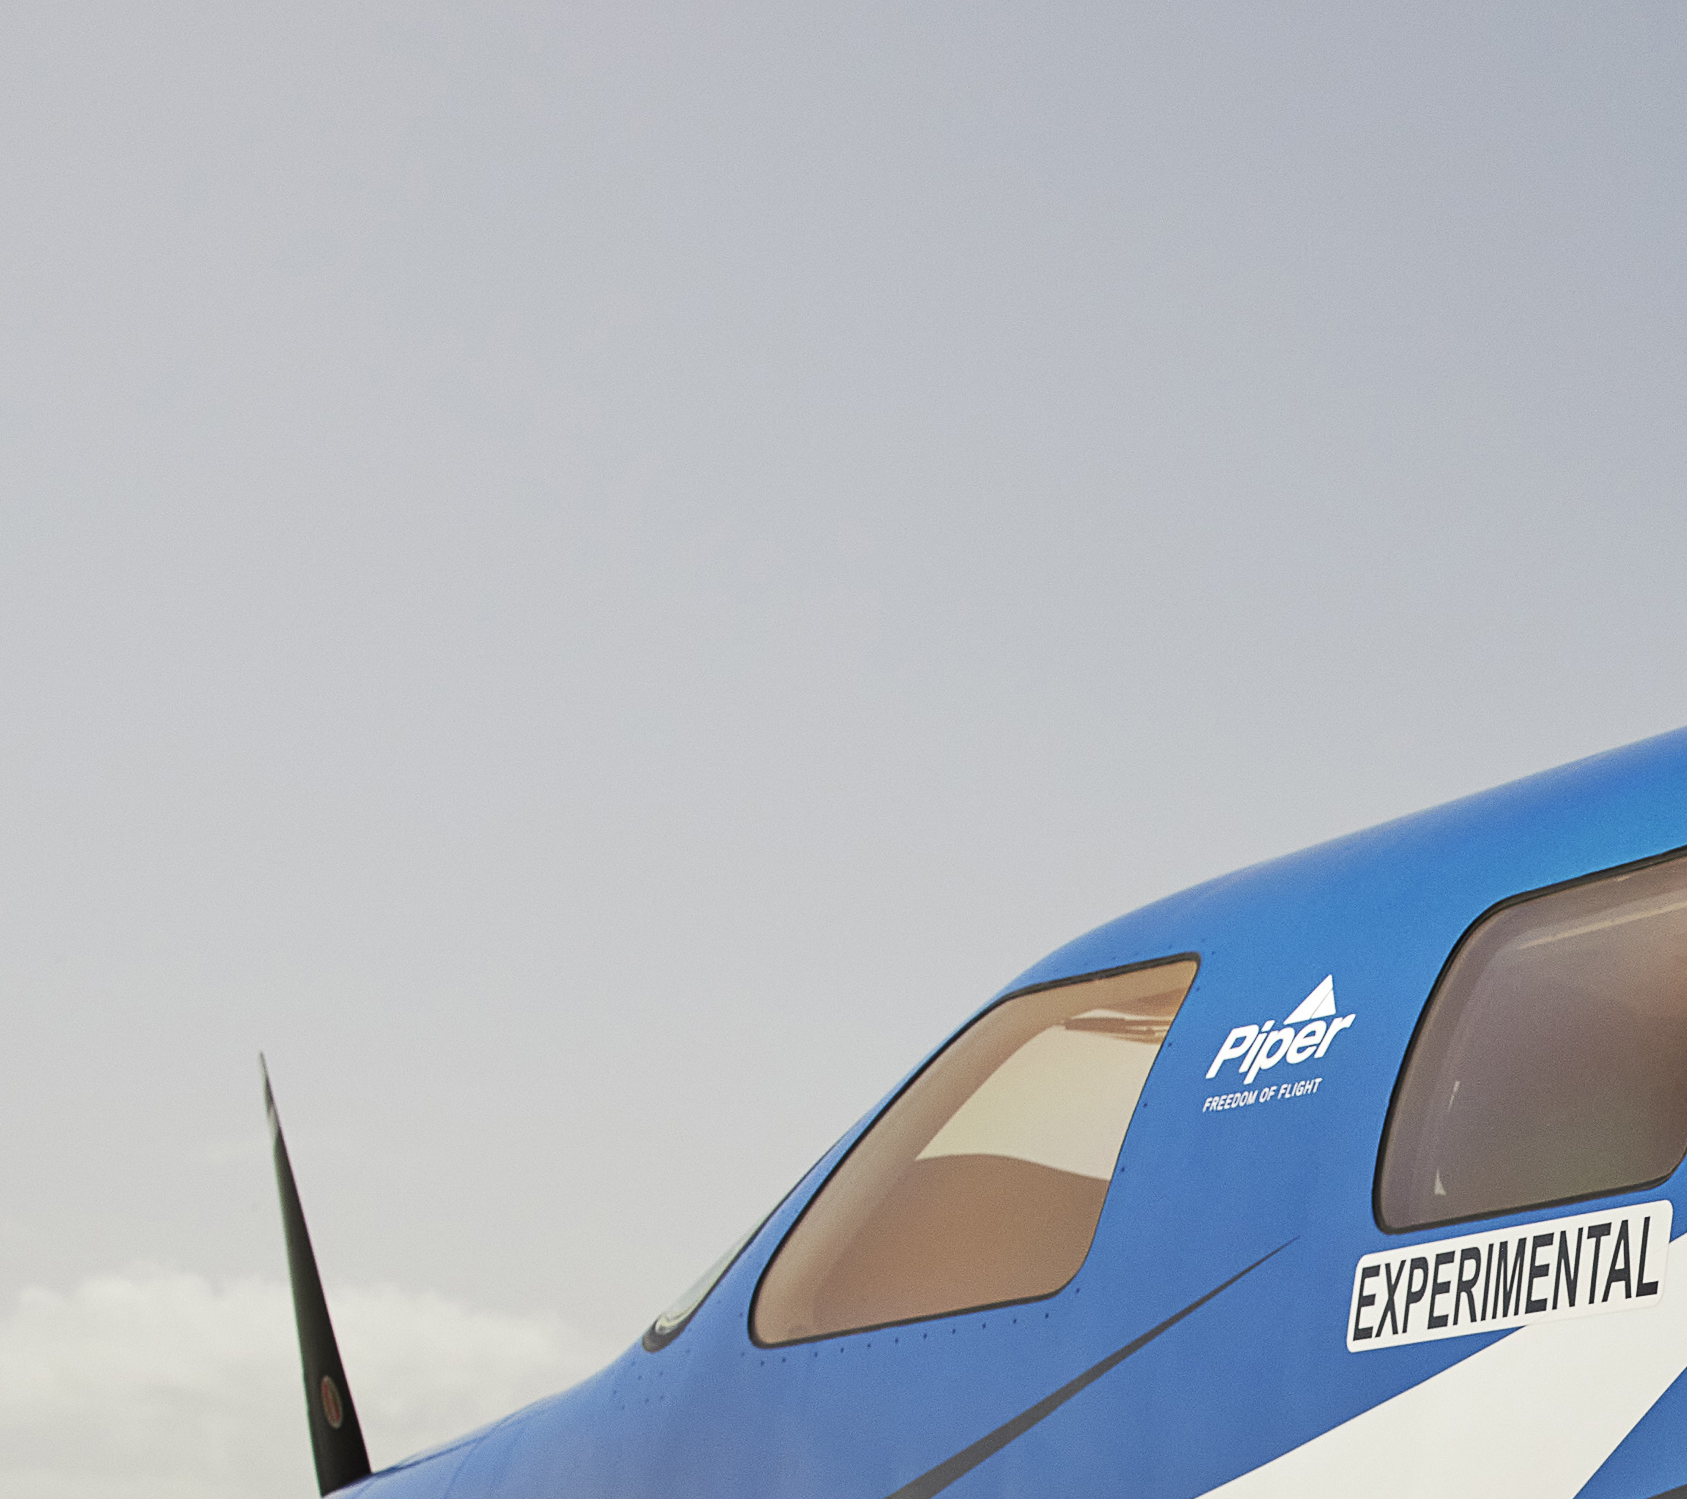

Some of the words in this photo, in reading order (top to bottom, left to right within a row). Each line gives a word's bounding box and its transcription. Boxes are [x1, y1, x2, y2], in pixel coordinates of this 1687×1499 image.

[1205, 1013, 1356, 1085] Piper
[1202, 1089, 1258, 1113] FREEDOM
[1259, 1085, 1278, 1103] OF
[1277, 1077, 1323, 1100] FLIGHT
[1352, 1216, 1660, 1342] EXPERIMENTAL
